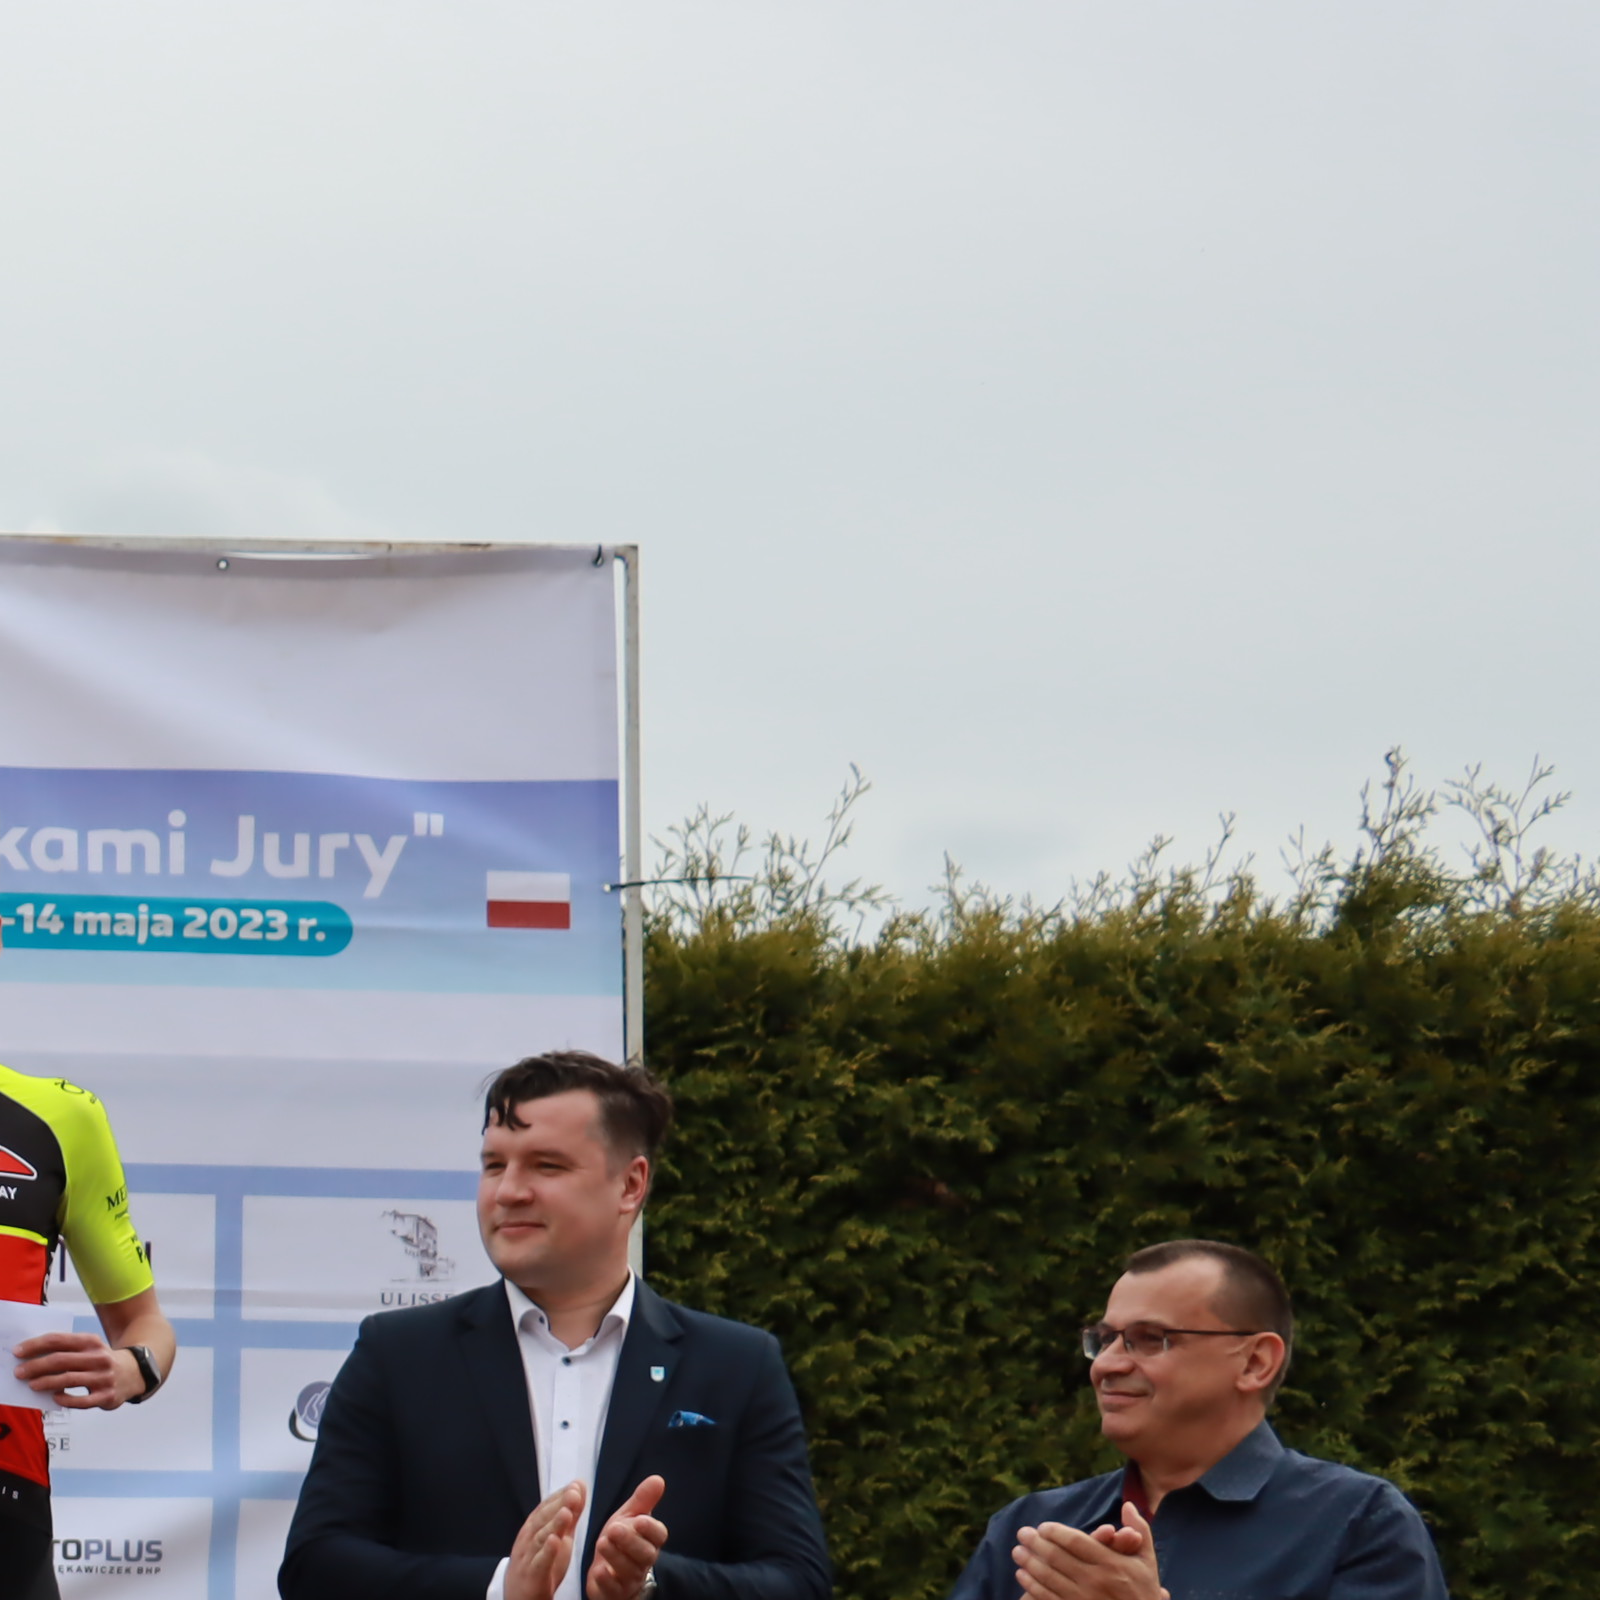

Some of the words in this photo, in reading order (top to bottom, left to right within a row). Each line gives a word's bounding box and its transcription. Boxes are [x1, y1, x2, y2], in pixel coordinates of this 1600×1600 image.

[210, 812, 443, 898] Jury"
[74, 905, 173, 945] maja
[183, 908, 287, 941] 2023
[298, 914, 326, 942] r.
